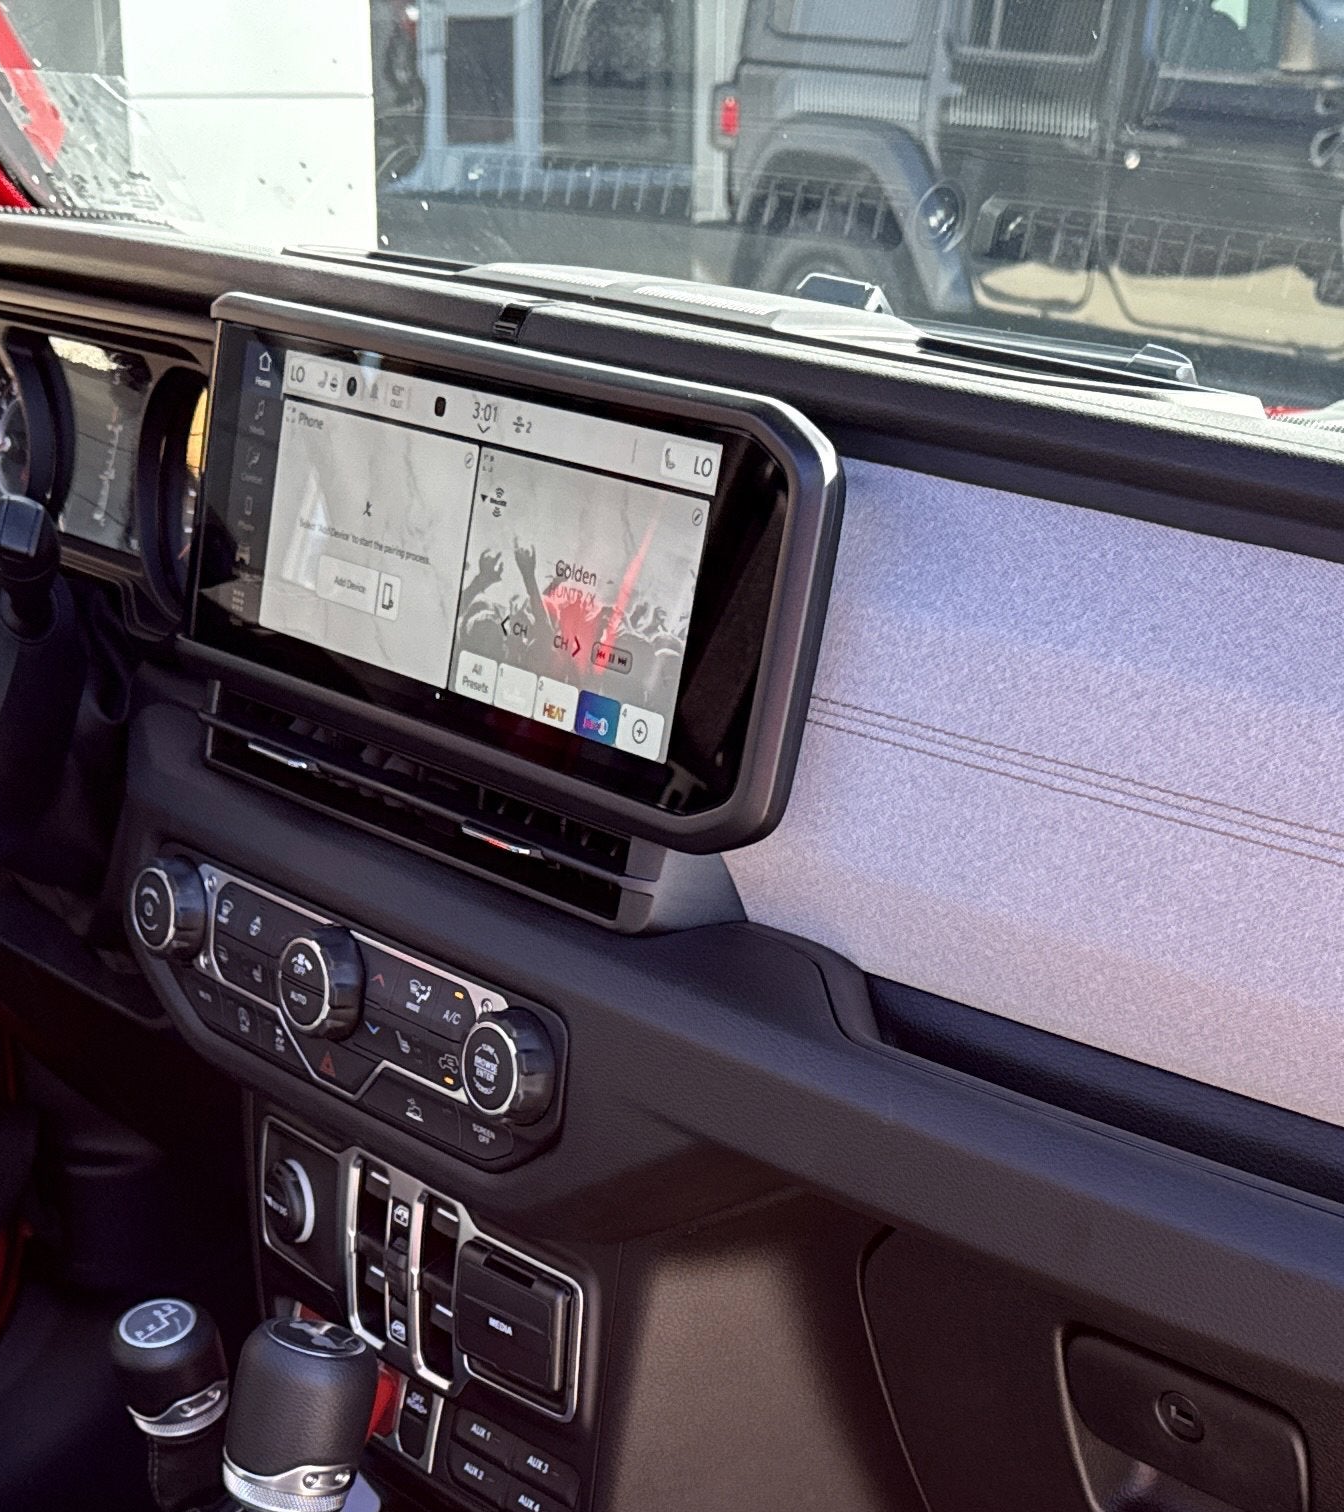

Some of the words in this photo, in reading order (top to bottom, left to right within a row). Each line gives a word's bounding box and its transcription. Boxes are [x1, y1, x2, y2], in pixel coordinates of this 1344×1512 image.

[290, 365, 306, 383] LO
[472, 401, 498, 421] 3:01
[298, 412, 324, 430] Phone
[693, 455, 713, 477] LO
[556, 559, 597, 587] Golden
[513, 623, 528, 636] CH
[553, 635, 568, 650] CH
[471, 663, 482, 676] All
[462, 675, 488, 694] Presets
[538, 680, 545, 691] 2
[543, 703, 566, 722] HEAT
[442, 1010, 461, 1025] A/C
[476, 1068, 495, 1083] ENTER
[472, 1123, 496, 1140] SCREEN
[478, 1134, 490, 1144] OFF
[488, 1316, 513, 1336] MEDIA
[470, 1423, 485, 1439] AUX
[486, 1431, 491, 1441] 1
[463, 1462, 478, 1478] AUX
[526, 1455, 542, 1471] AUX
[518, 1494, 533, 1510] AUX
[534, 1502, 541, 1512] 4
